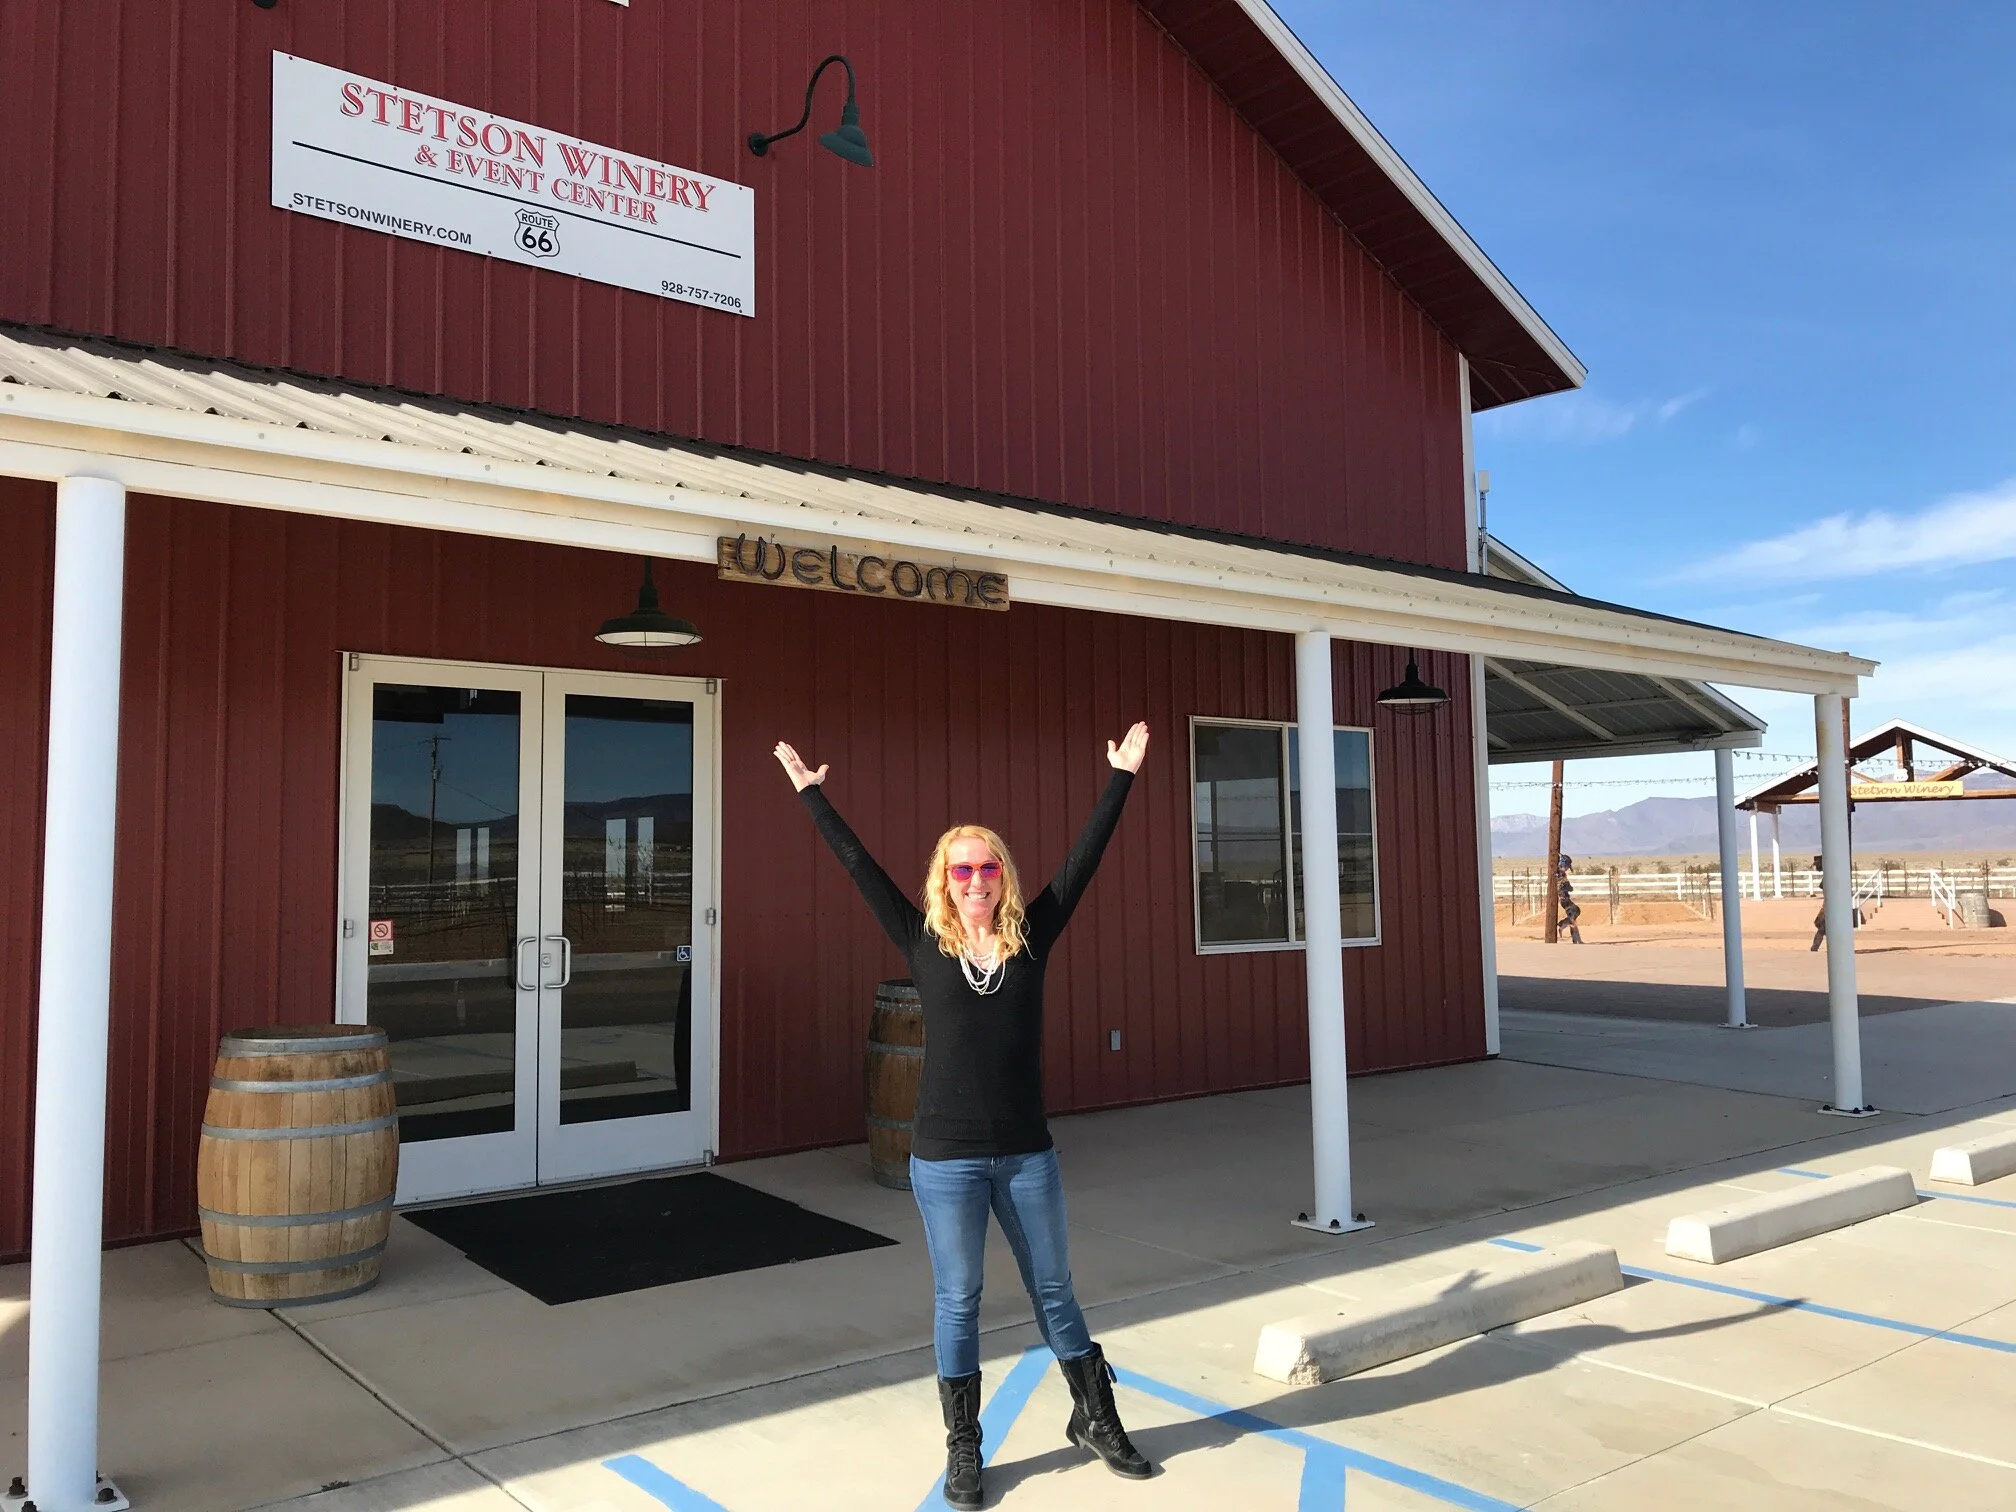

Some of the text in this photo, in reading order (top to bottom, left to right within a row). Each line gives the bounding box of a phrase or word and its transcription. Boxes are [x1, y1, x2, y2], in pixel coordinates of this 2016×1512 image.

[340, 82, 716, 212] STETSON WINERY
[415, 144, 658, 224] & EVENT CENTER
[293, 193, 472, 245] STETSONWINERY.COM
[521, 213, 553, 228] ROUTE
[522, 226, 552, 252] 66
[661, 280, 741, 308] 928-757-7206
[1851, 784, 1954, 797] Stetson Winery
